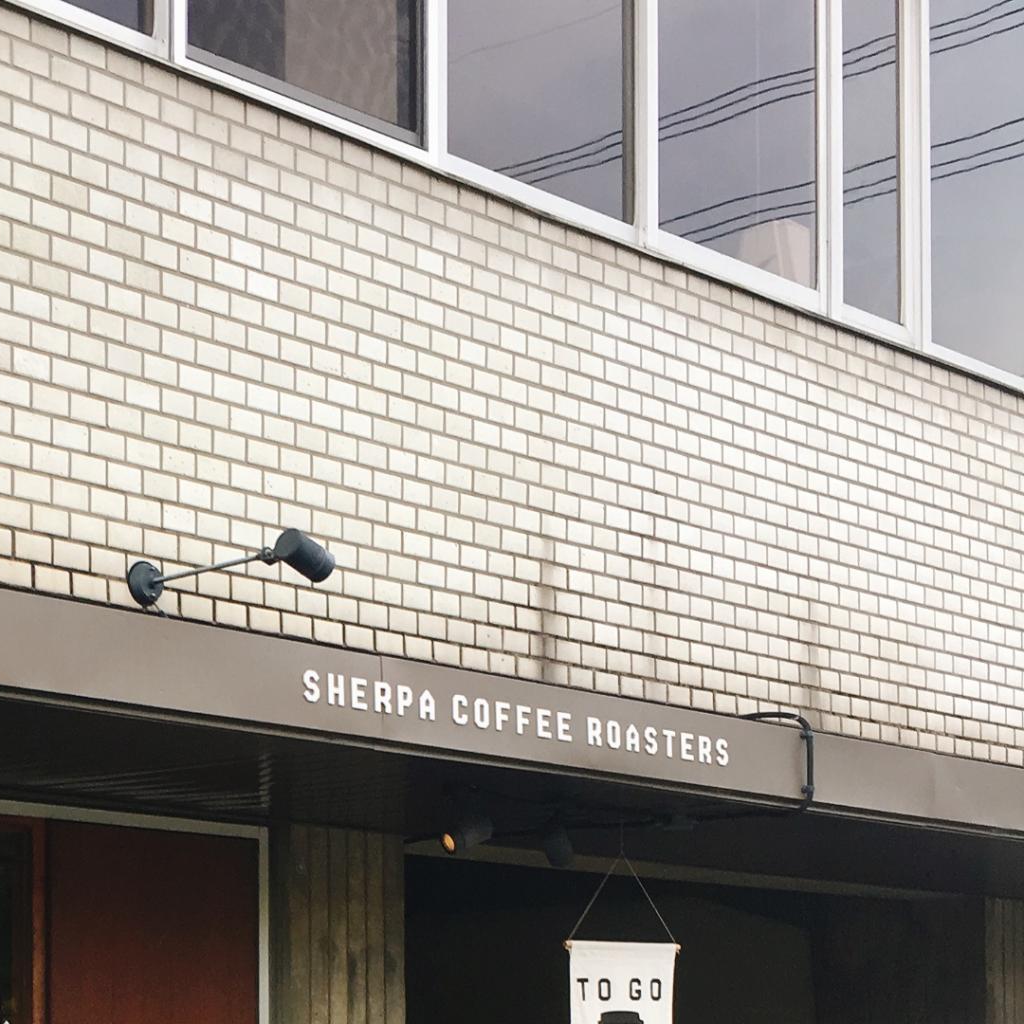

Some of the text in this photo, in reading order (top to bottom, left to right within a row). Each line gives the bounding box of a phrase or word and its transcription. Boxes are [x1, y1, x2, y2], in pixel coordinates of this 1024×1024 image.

[302, 669, 730, 766] SHERPA COFFEE ROASTERS
[577, 978, 663, 1001] TO GO
